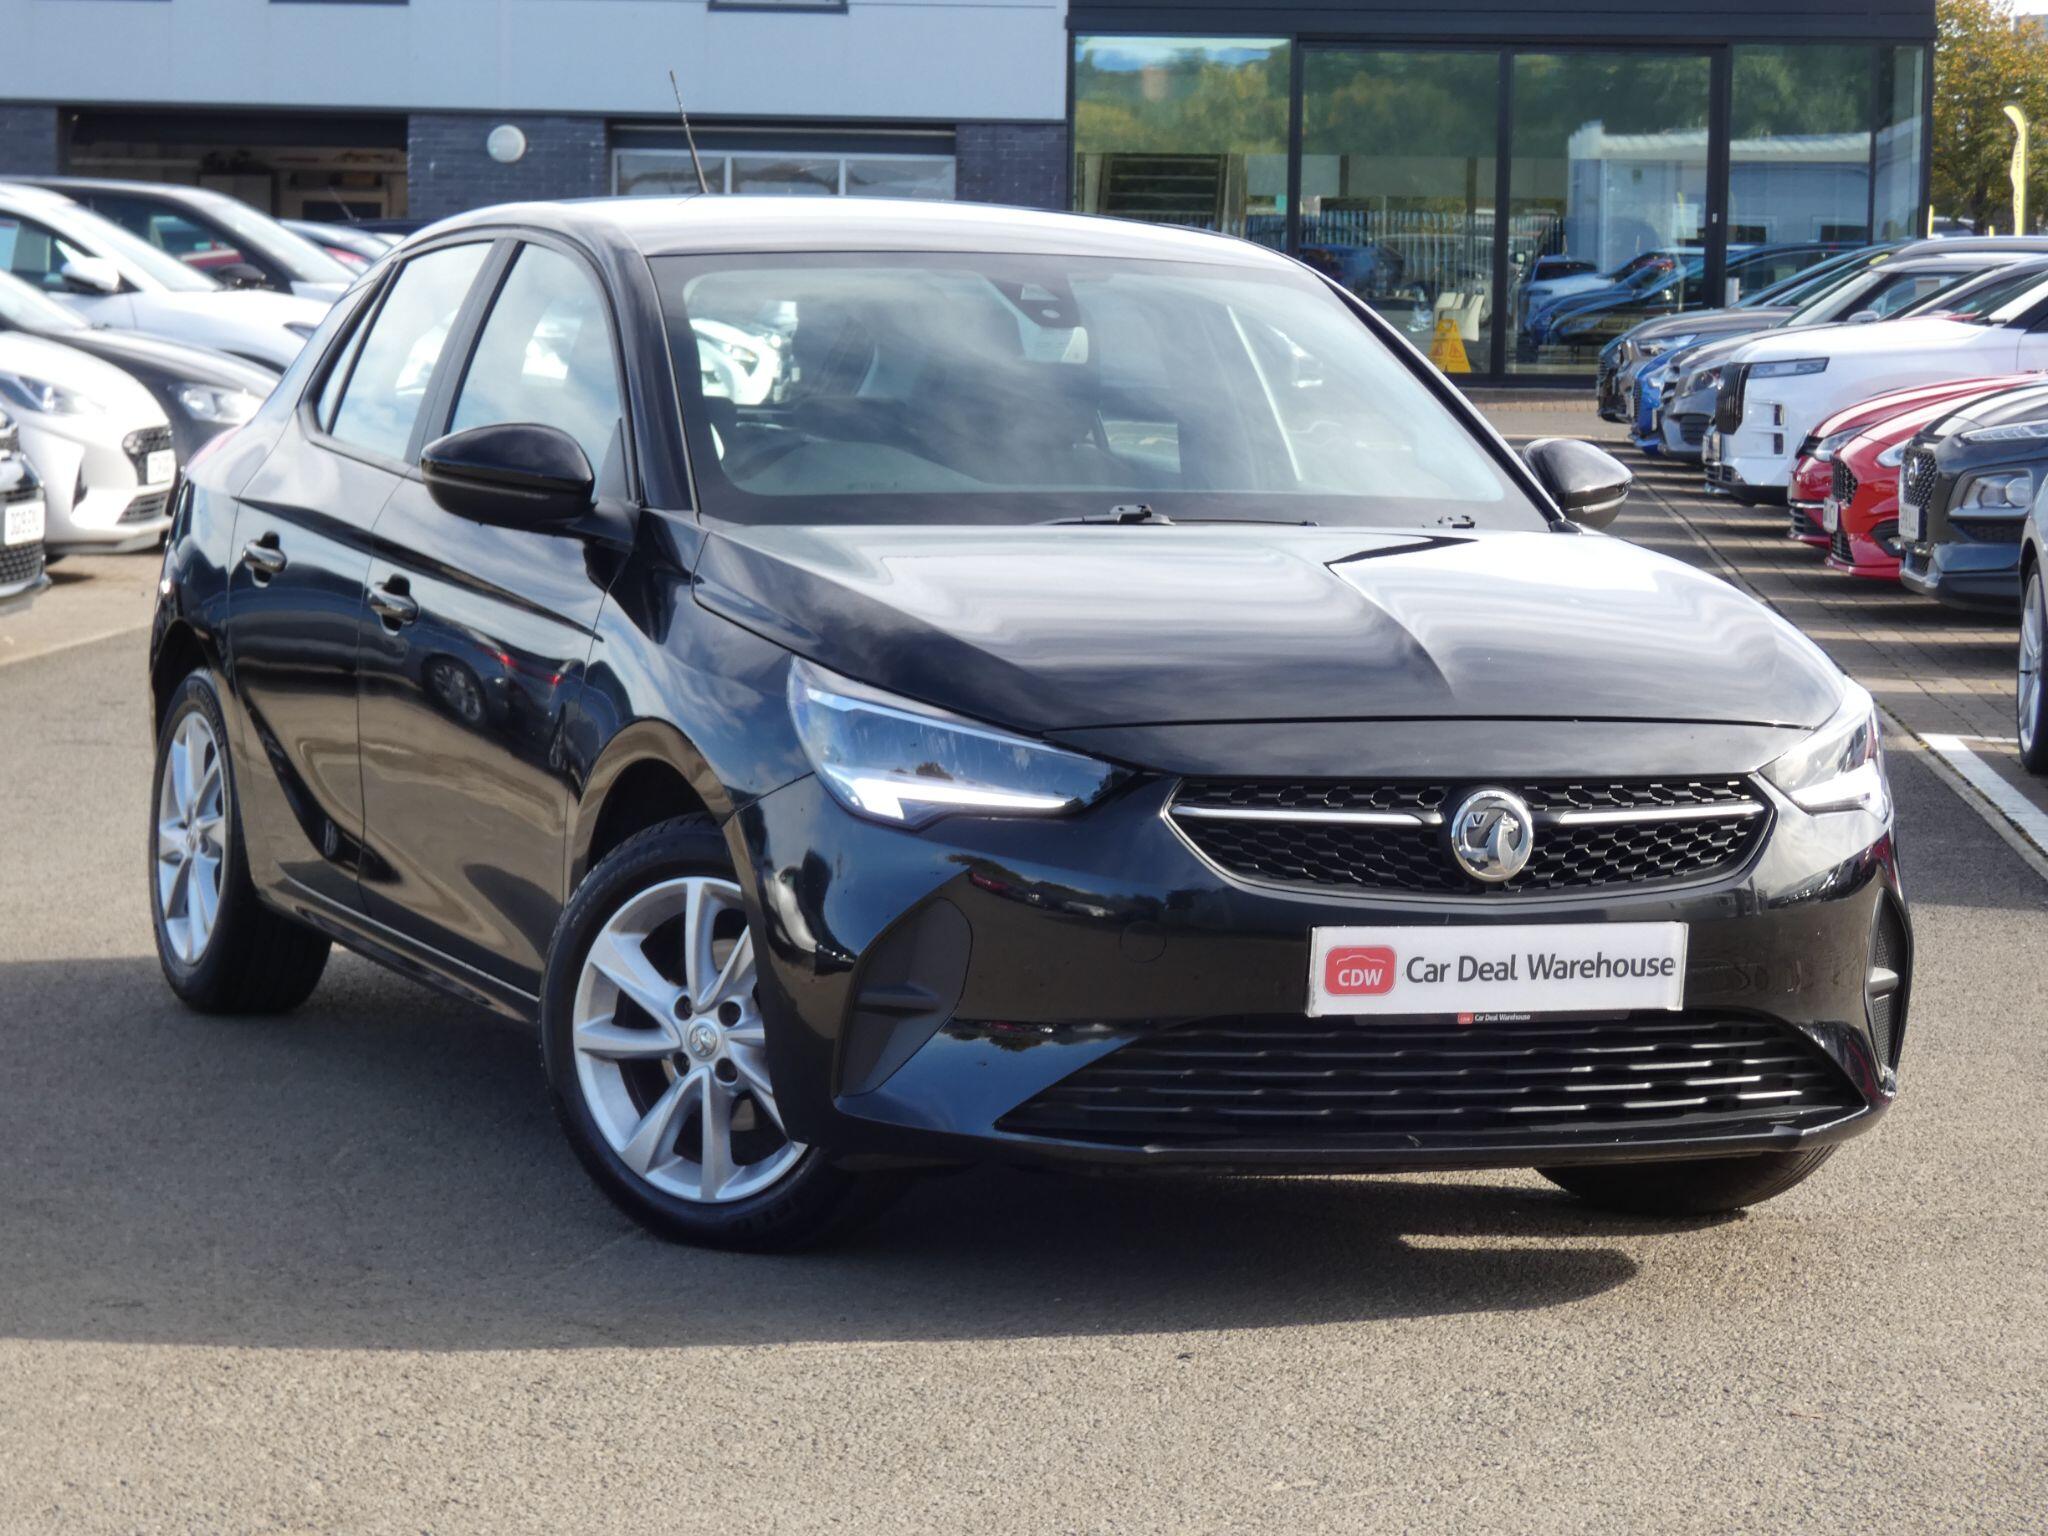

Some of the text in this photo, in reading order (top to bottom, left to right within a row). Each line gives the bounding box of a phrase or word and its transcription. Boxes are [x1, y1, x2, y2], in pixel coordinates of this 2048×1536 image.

[1406, 951, 1675, 983] Car Deal Warehouse
[1338, 969, 1383, 987] CDW
[1474, 1013, 1484, 1021] Car
[1499, 1013, 1531, 1021] Warehouse
